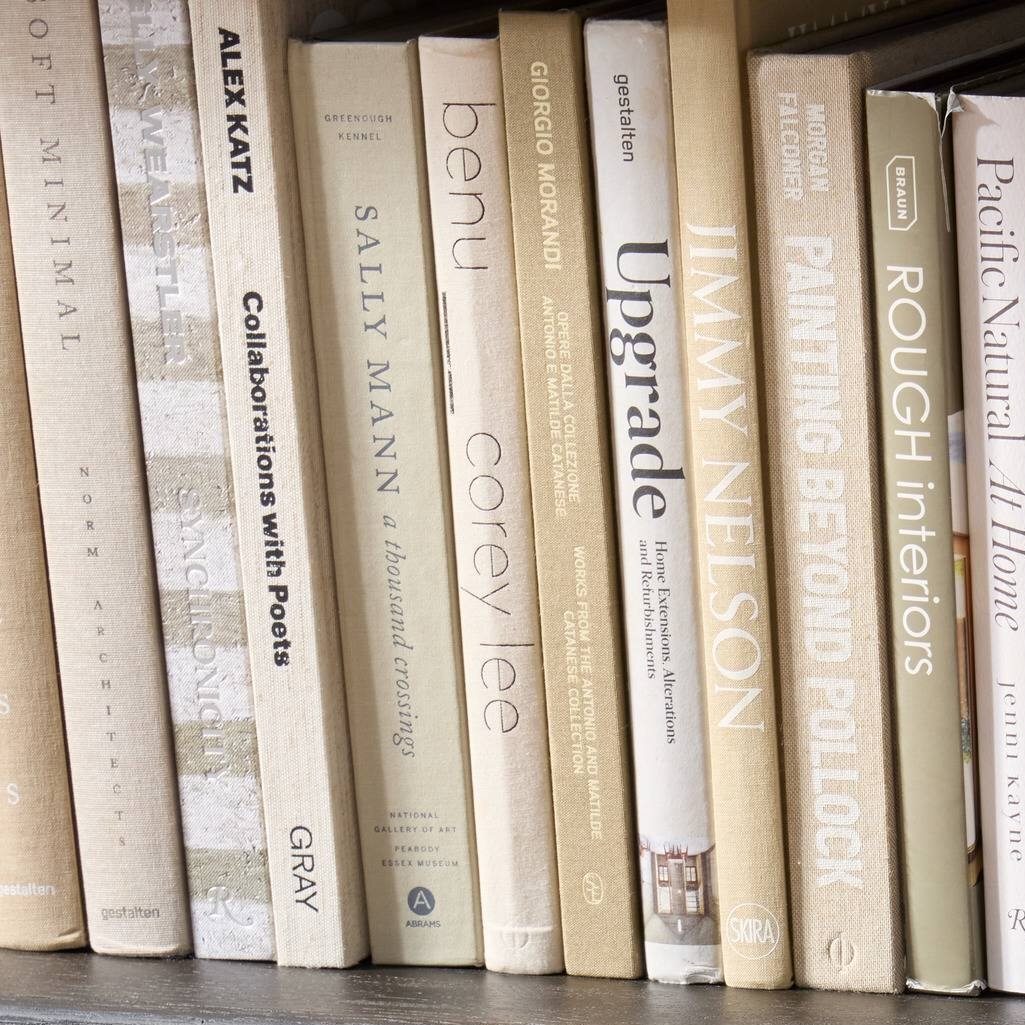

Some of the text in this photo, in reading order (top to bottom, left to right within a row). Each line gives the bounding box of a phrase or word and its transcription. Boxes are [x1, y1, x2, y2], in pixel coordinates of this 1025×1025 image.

[27, 0, 80, 351] OFT MINIMAL
[218, 27, 254, 193] ALEX KATZ
[324, 113, 393, 123] GREENOUGH
[338, 132, 382, 141] KENNEL
[443, 103, 496, 270] benu
[531, 61, 562, 270] GIORGIO MORANDI
[613, 74, 636, 162] gestalten
[779, 92, 803, 200] FALCONER
[805, 103, 830, 191] MORGAN
[895, 167, 908, 219] BRAUN
[141, 106, 190, 365] WEARSTLER
[977, 157, 1020, 288] Pacific
[355, 205, 400, 495] SALLY MANN
[542, 295, 568, 518] ANTONIO E MATILDE CATANESE
[557, 311, 580, 503] OPERE DALLA COLLEZIONE
[605, 239, 685, 519] Upgrade
[982, 296, 1025, 441] Natural
[243, 291, 292, 667] Collaborations with Poets
[686, 224, 766, 733] JIMMY NELSON
[887, 265, 940, 675] ROUGH interiors
[989, 459, 1025, 510] At
[178, 488, 231, 781] SYNCHRONICITY
[383, 515, 419, 758] a thousand crossings
[460, 432, 535, 733] corey lee
[640, 539, 656, 680] and Refurbishments
[655, 541, 667, 583] Home
[663, 667, 677, 744] Alterations
[784, 236, 864, 888] PAINTING BEYOND POLLOCK
[79, 467, 126, 847] NORM ARCHITECTS
[563, 610, 585, 774] CATANESE COLLECTION
[573, 545, 602, 841] WORKS FROM THE ANTONIO AND MATILDE
[289, 826, 318, 912] GRAY
[1003, 776, 1024, 861] kayne
[101, 905, 160, 920] gestalten
[405, 920, 441, 928] ABRAMS
[730, 917, 776, 944] SKIRA
